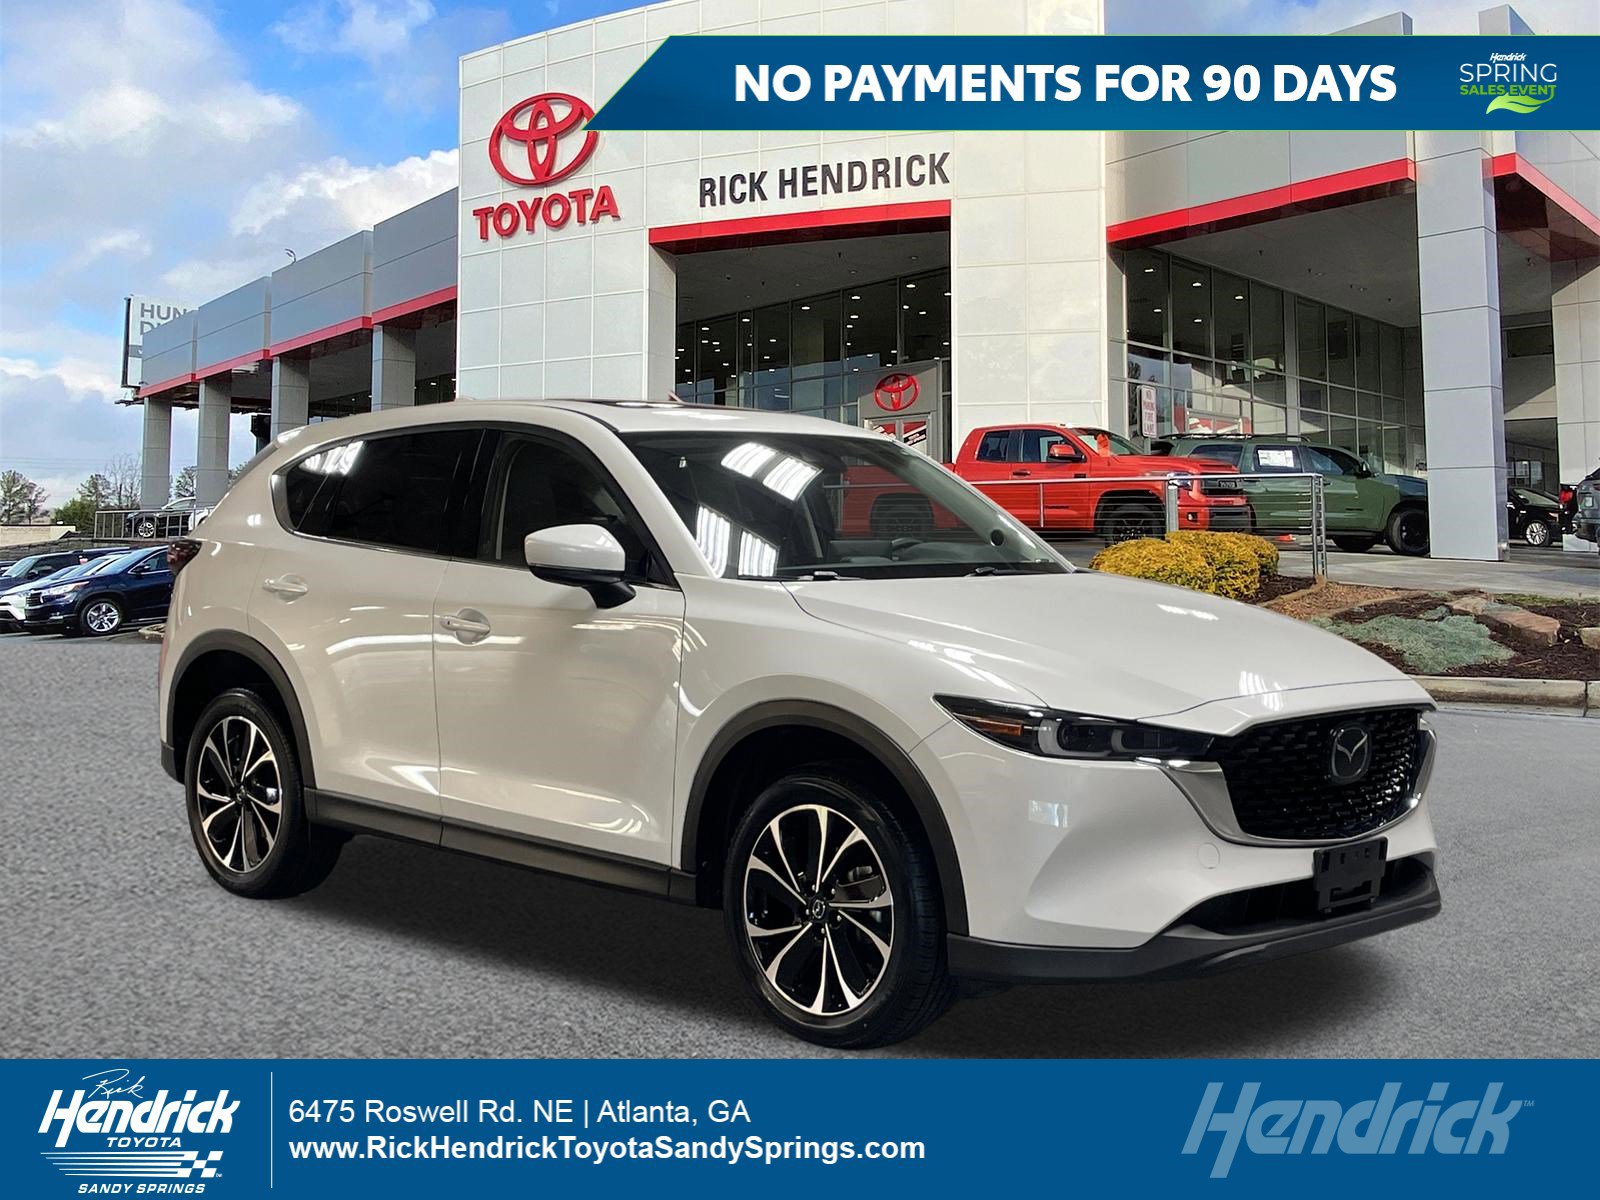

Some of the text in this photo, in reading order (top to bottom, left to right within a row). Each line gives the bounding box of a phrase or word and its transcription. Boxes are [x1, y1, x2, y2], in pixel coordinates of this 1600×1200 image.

[699, 152, 950, 208] RICK HENDRICK
[472, 185, 621, 241] TOYOTA
